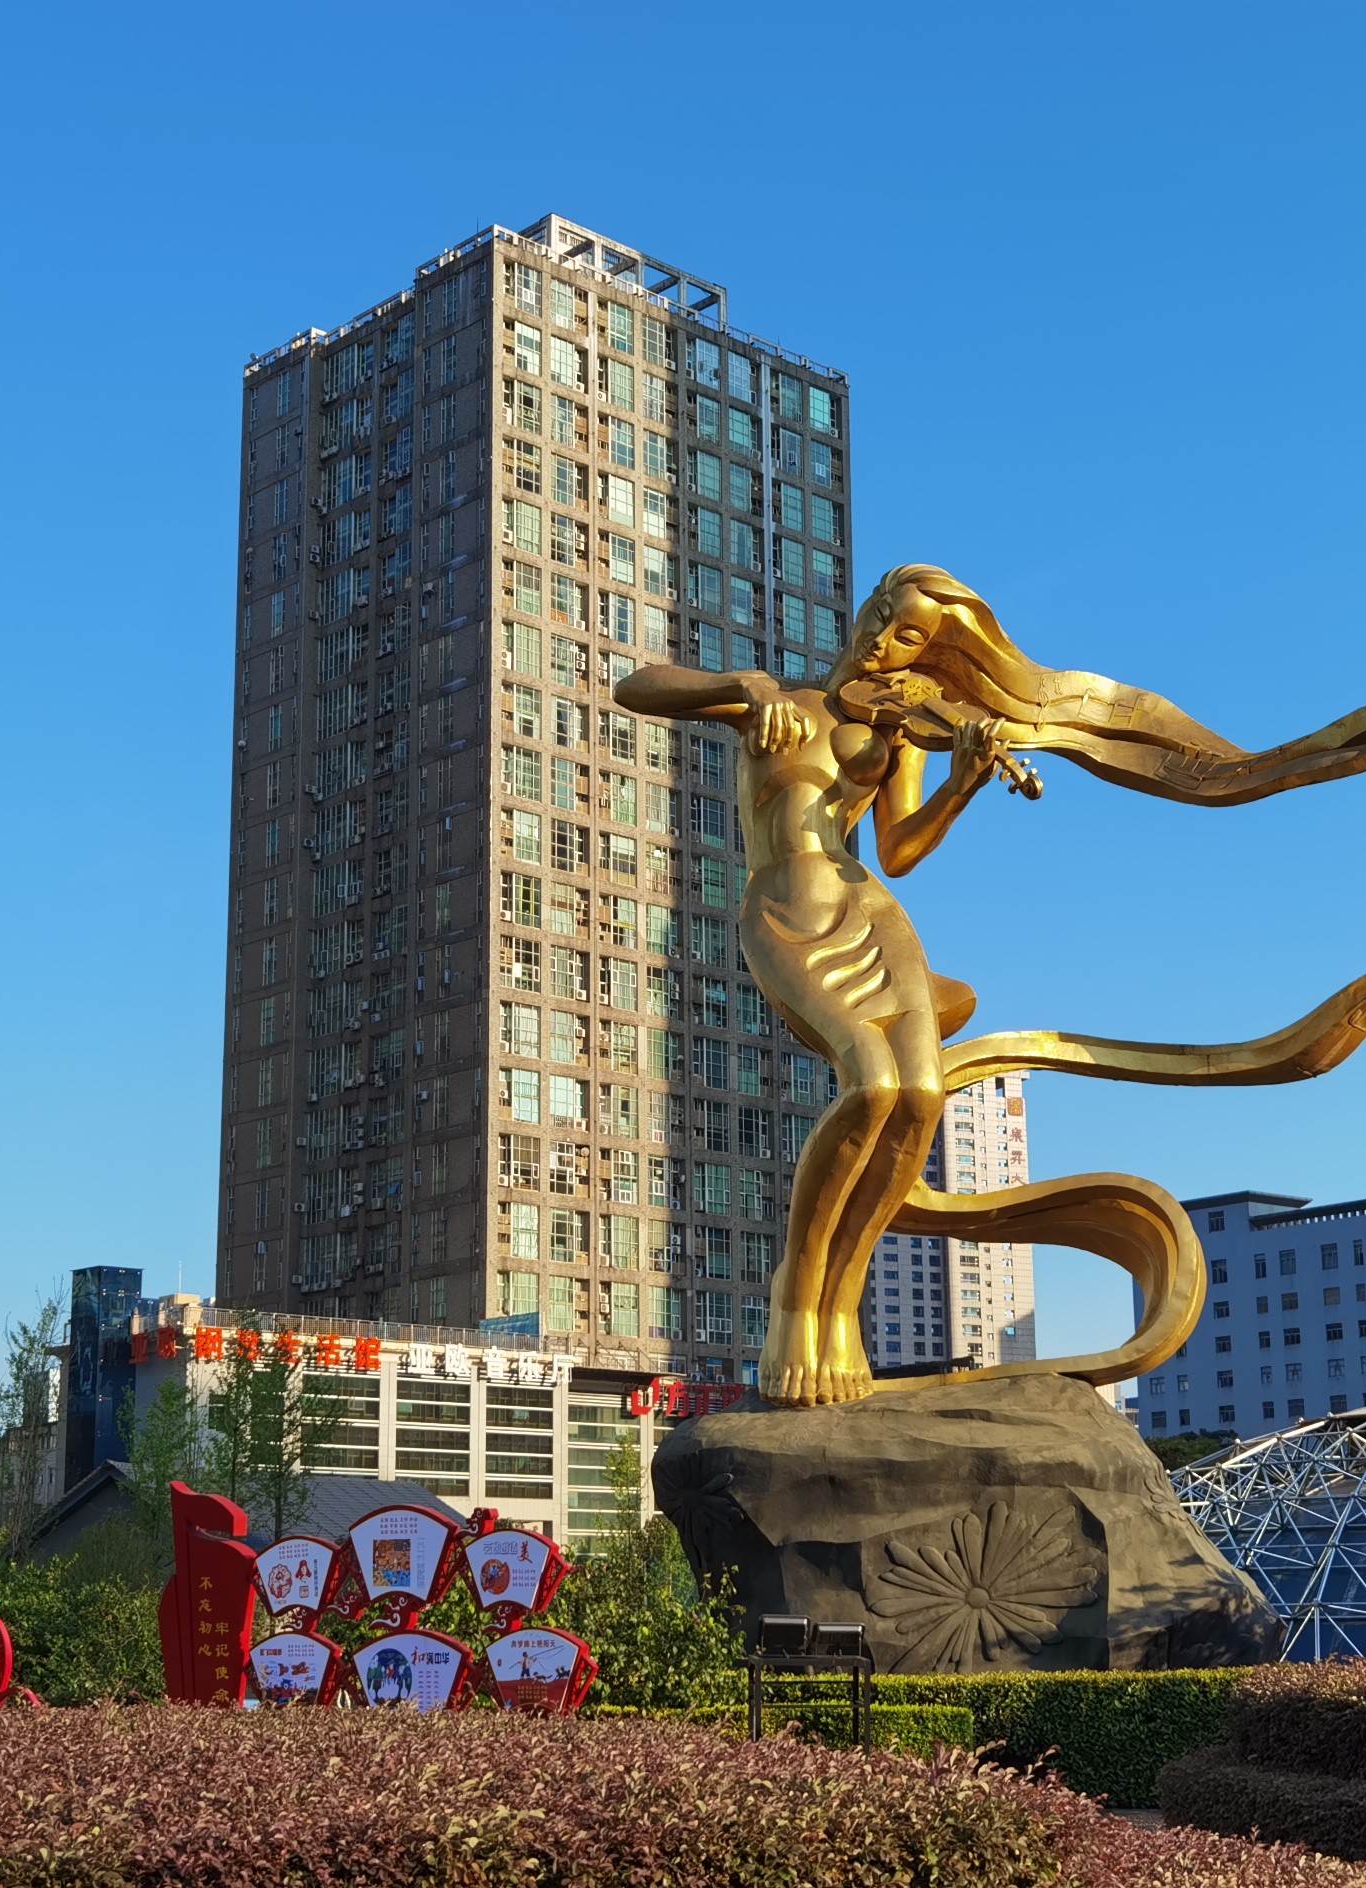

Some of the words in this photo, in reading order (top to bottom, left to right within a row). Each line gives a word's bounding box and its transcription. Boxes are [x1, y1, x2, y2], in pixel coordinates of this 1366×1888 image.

[407, 1342, 576, 1383] 亚欧音乐厅
[198, 1576, 213, 1656] 不忘初心
